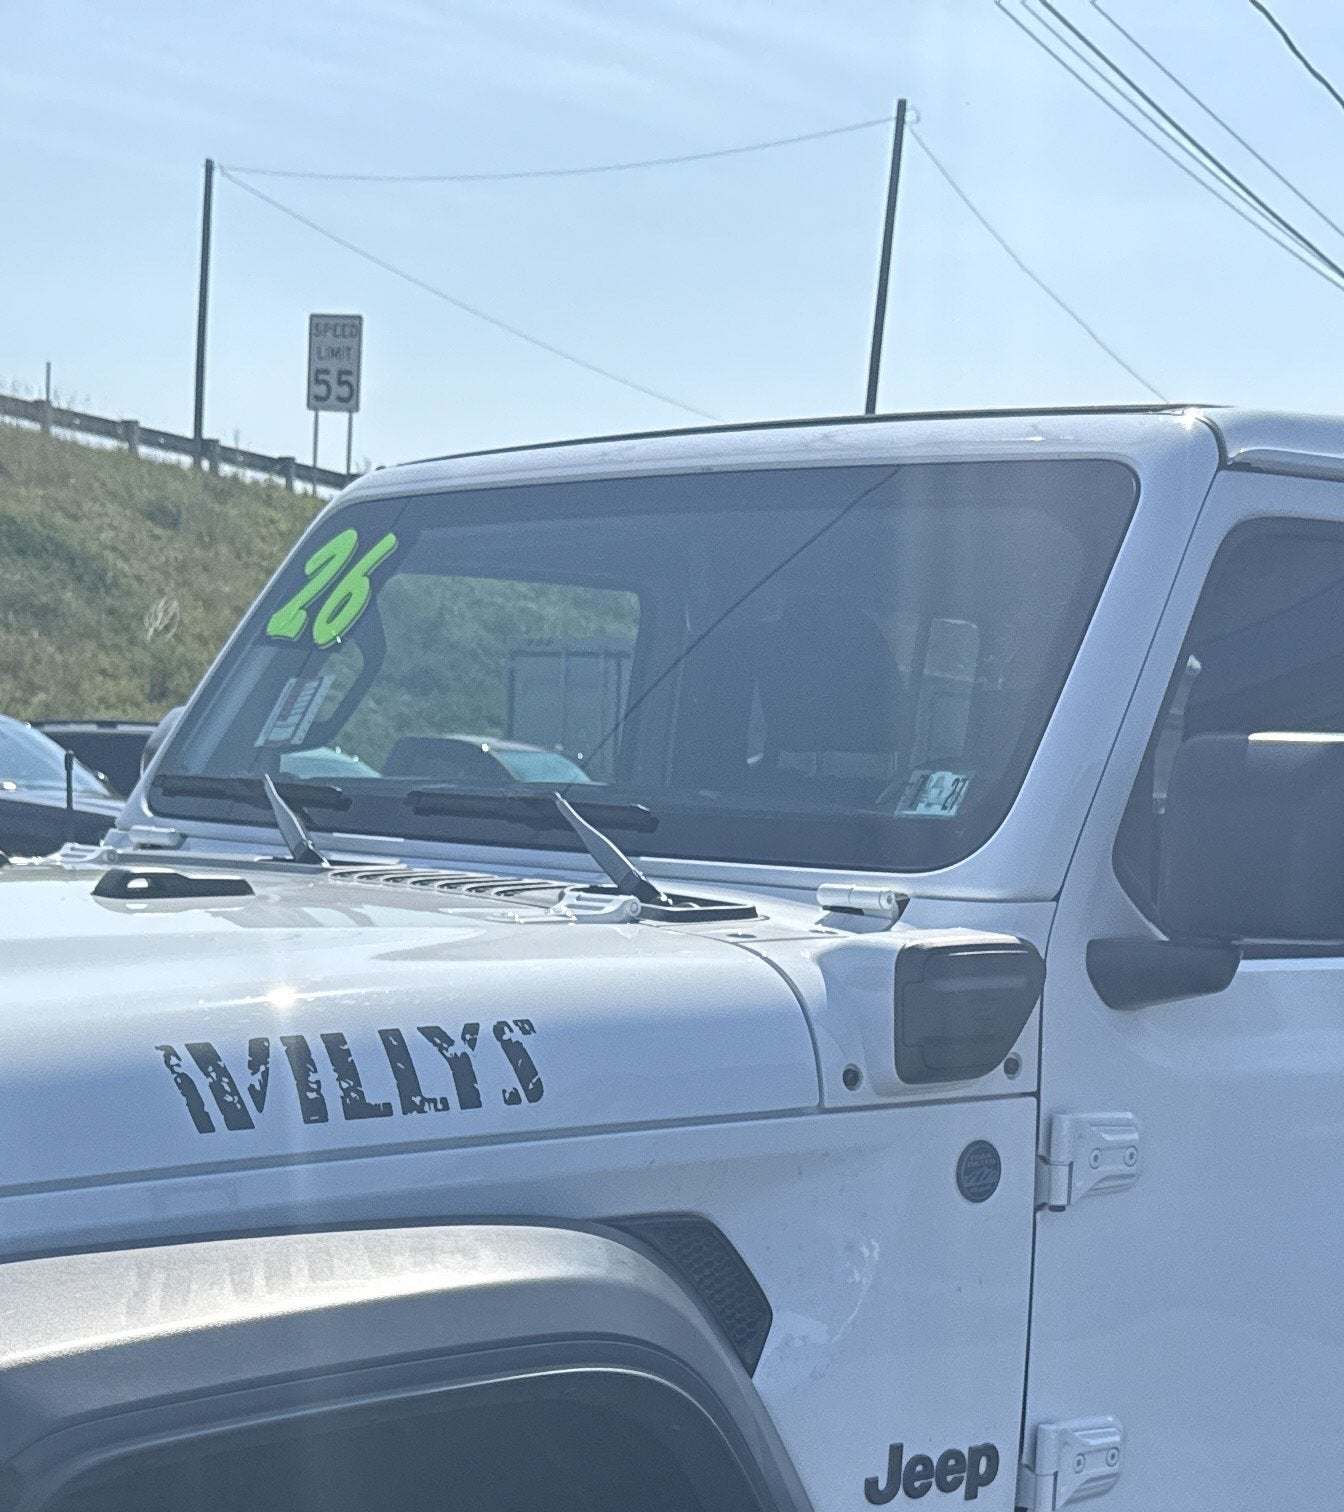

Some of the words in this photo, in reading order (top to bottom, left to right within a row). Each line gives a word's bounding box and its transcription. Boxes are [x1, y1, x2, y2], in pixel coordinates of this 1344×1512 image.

[313, 322, 358, 338] SPEED
[315, 345, 352, 361] LIMIT
[313, 368, 355, 403] 55
[266, 528, 399, 650] 26
[155, 1018, 545, 1134] WILLYS
[864, 1442, 1000, 1506] Jeep
